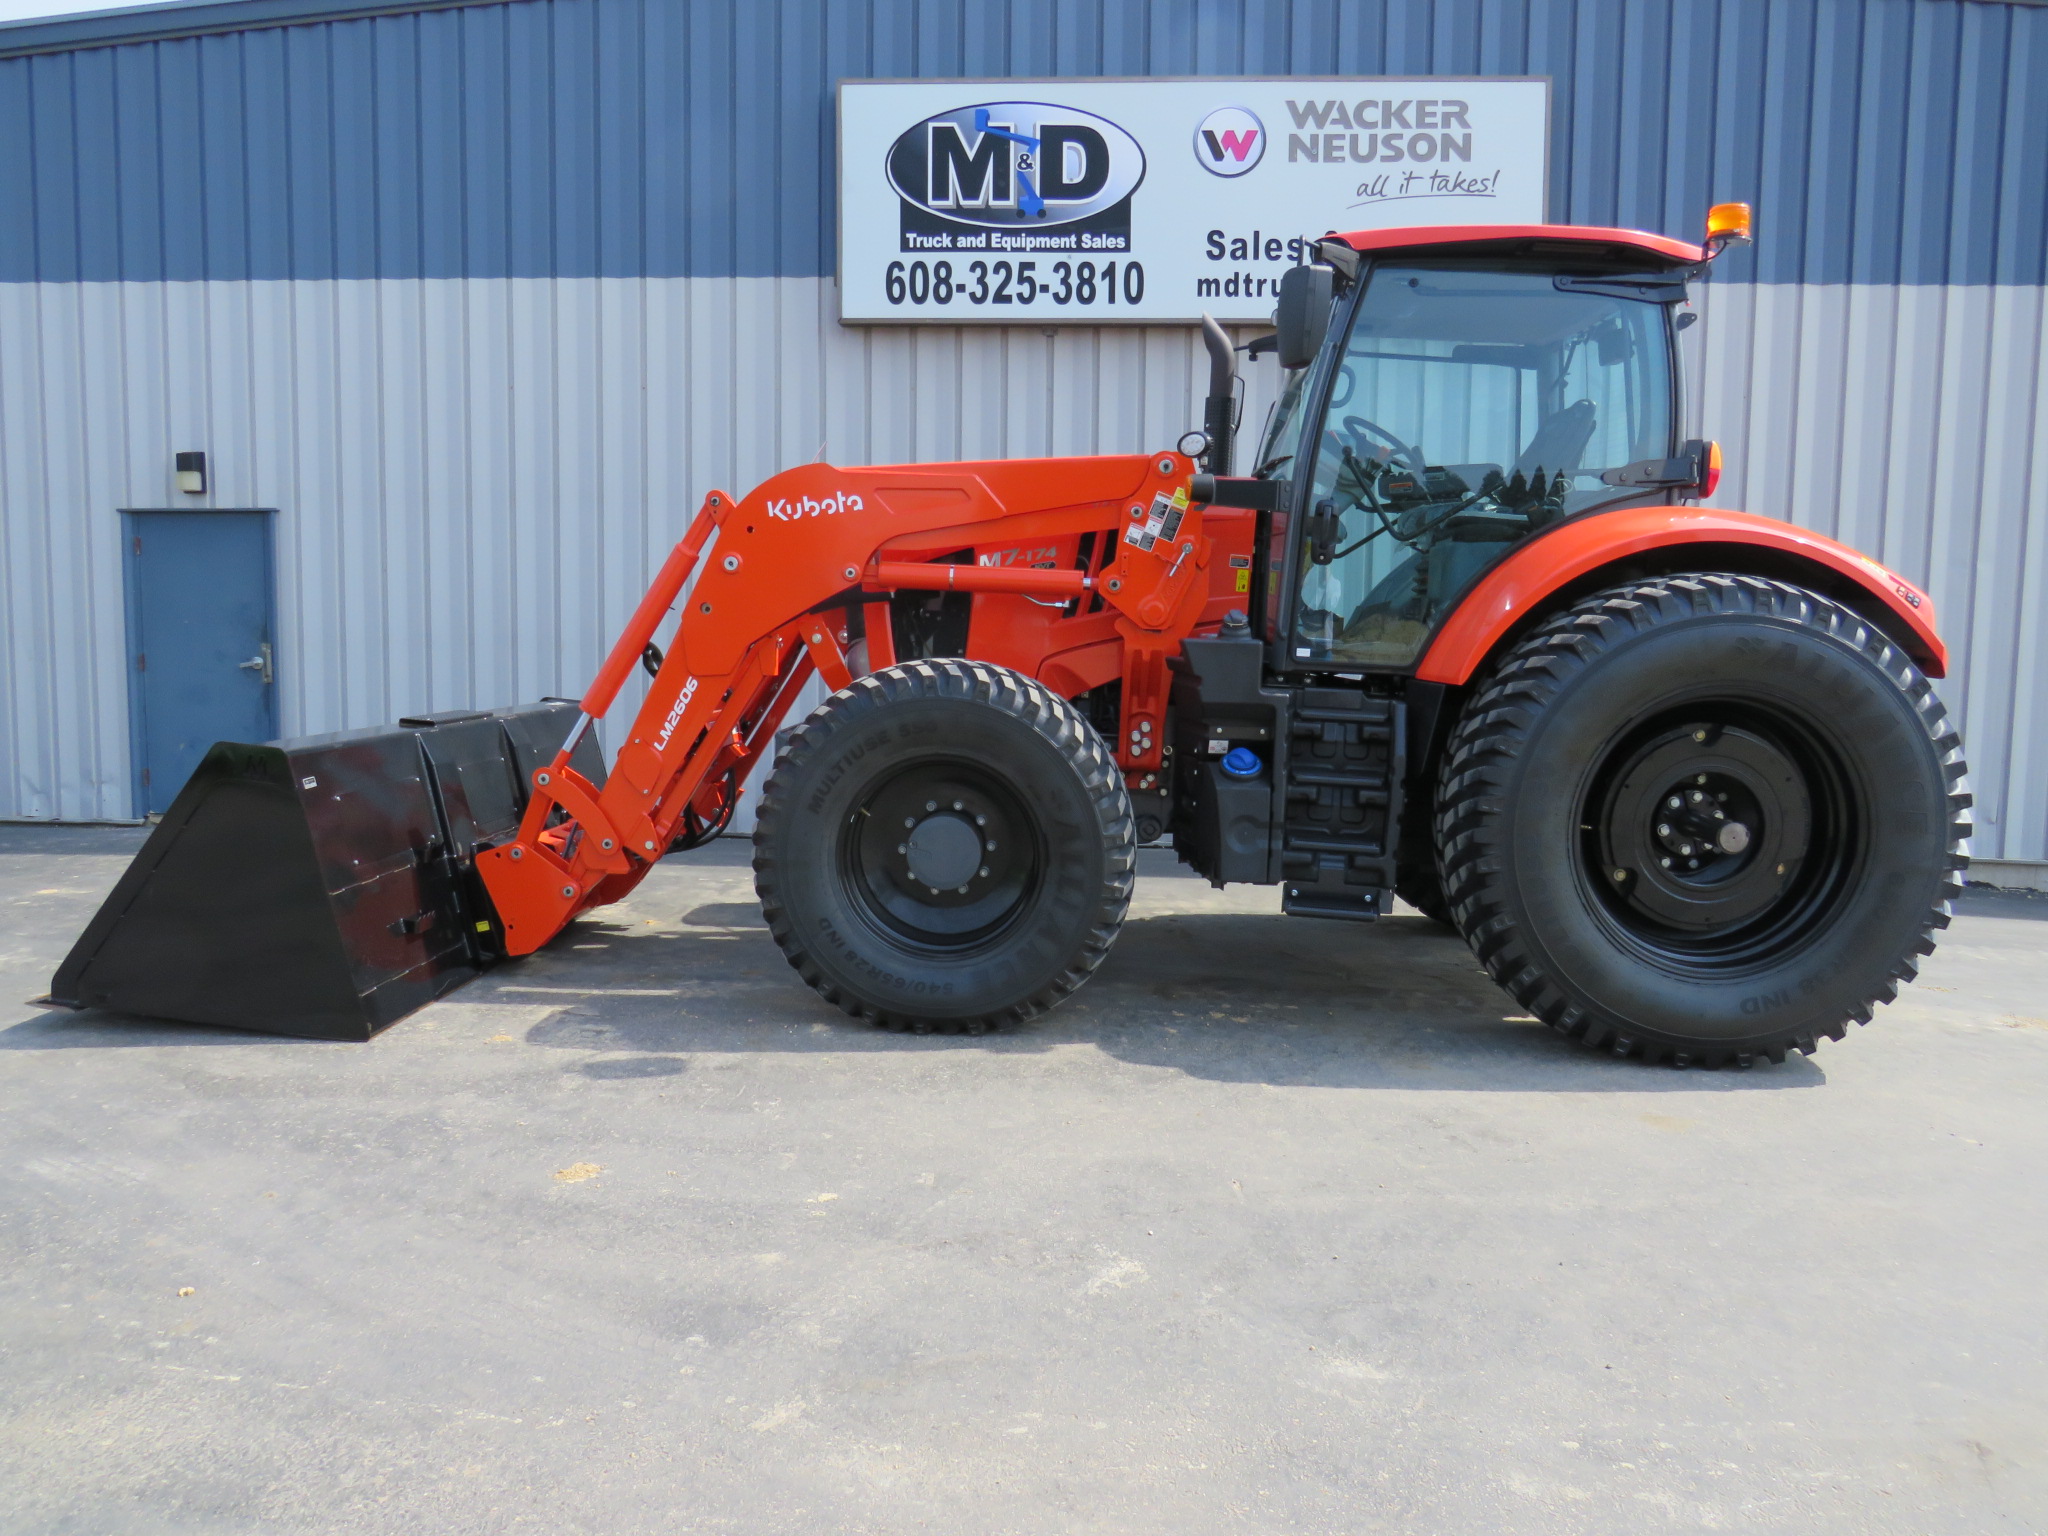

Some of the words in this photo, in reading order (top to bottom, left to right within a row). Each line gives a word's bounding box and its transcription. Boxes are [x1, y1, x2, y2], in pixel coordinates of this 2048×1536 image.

[1285, 99, 1472, 130] WACKER
[1288, 133, 1472, 163] NEUSON
[1356, 174, 1390, 197] all
[1399, 170, 1424, 194] it
[1429, 169, 1501, 193] takes!
[905, 232, 952, 249] Truck
[956, 232, 986, 249] and
[991, 232, 1077, 252] Equipment
[1081, 232, 1126, 249] Sales
[1206, 229, 1301, 261] Sales
[885, 260, 1144, 305] 608-325-3810
[767, 491, 864, 521] Kubota
[653, 675, 698, 752] LM2606
[807, 730, 892, 815] MULTIUSE
